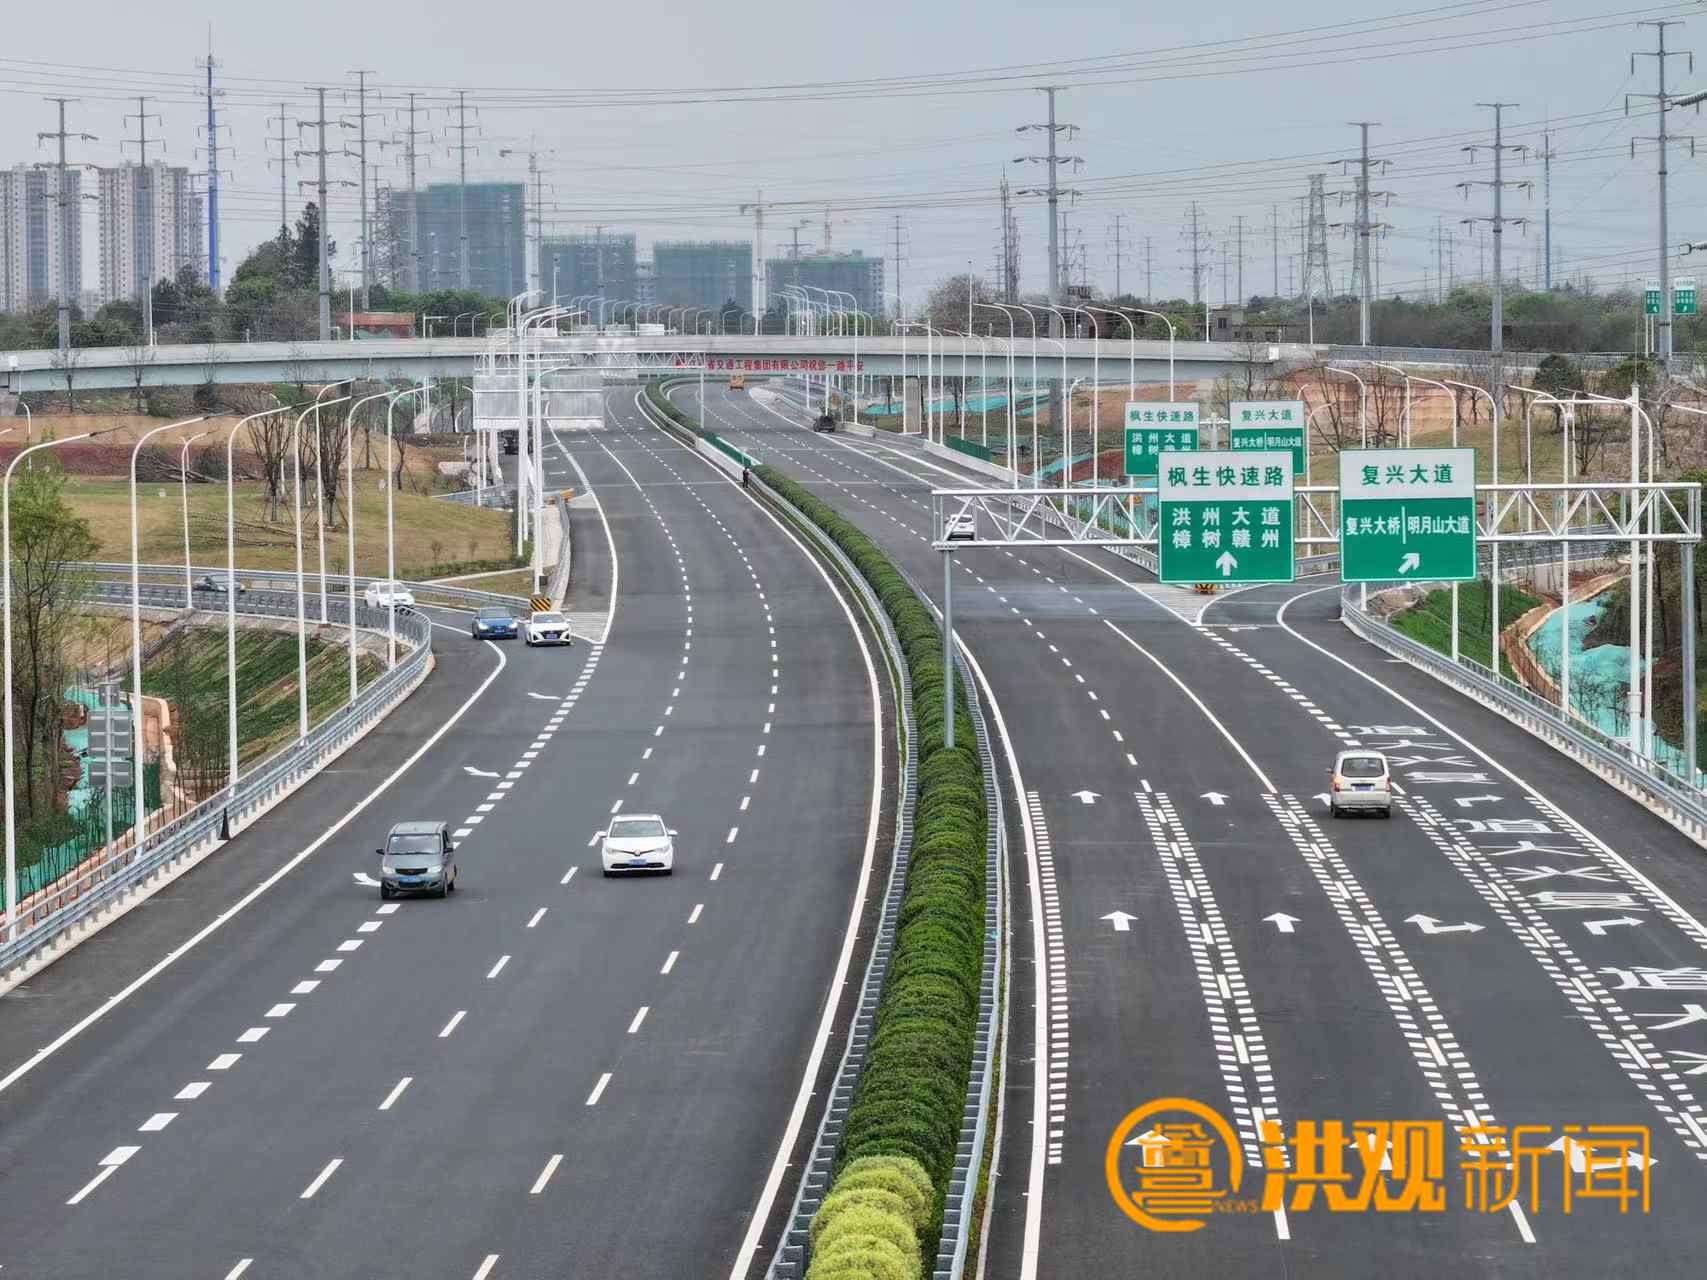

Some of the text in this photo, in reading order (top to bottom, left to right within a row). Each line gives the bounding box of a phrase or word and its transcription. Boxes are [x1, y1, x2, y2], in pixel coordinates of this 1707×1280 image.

[1130, 410, 1194, 422] 枫生快速路
[1241, 409, 1292, 421] 复兴大道
[1132, 432, 1192, 444] 洪州大道
[1233, 436, 1302, 448] 复兴大桥 明月山大道
[1168, 466, 1284, 487] 枫生快速路
[1361, 464, 1453, 485] 复兴大道
[1172, 506, 1280, 527] 洪州大道
[1346, 515, 1470, 536] 复兴大桥 明月山大道
